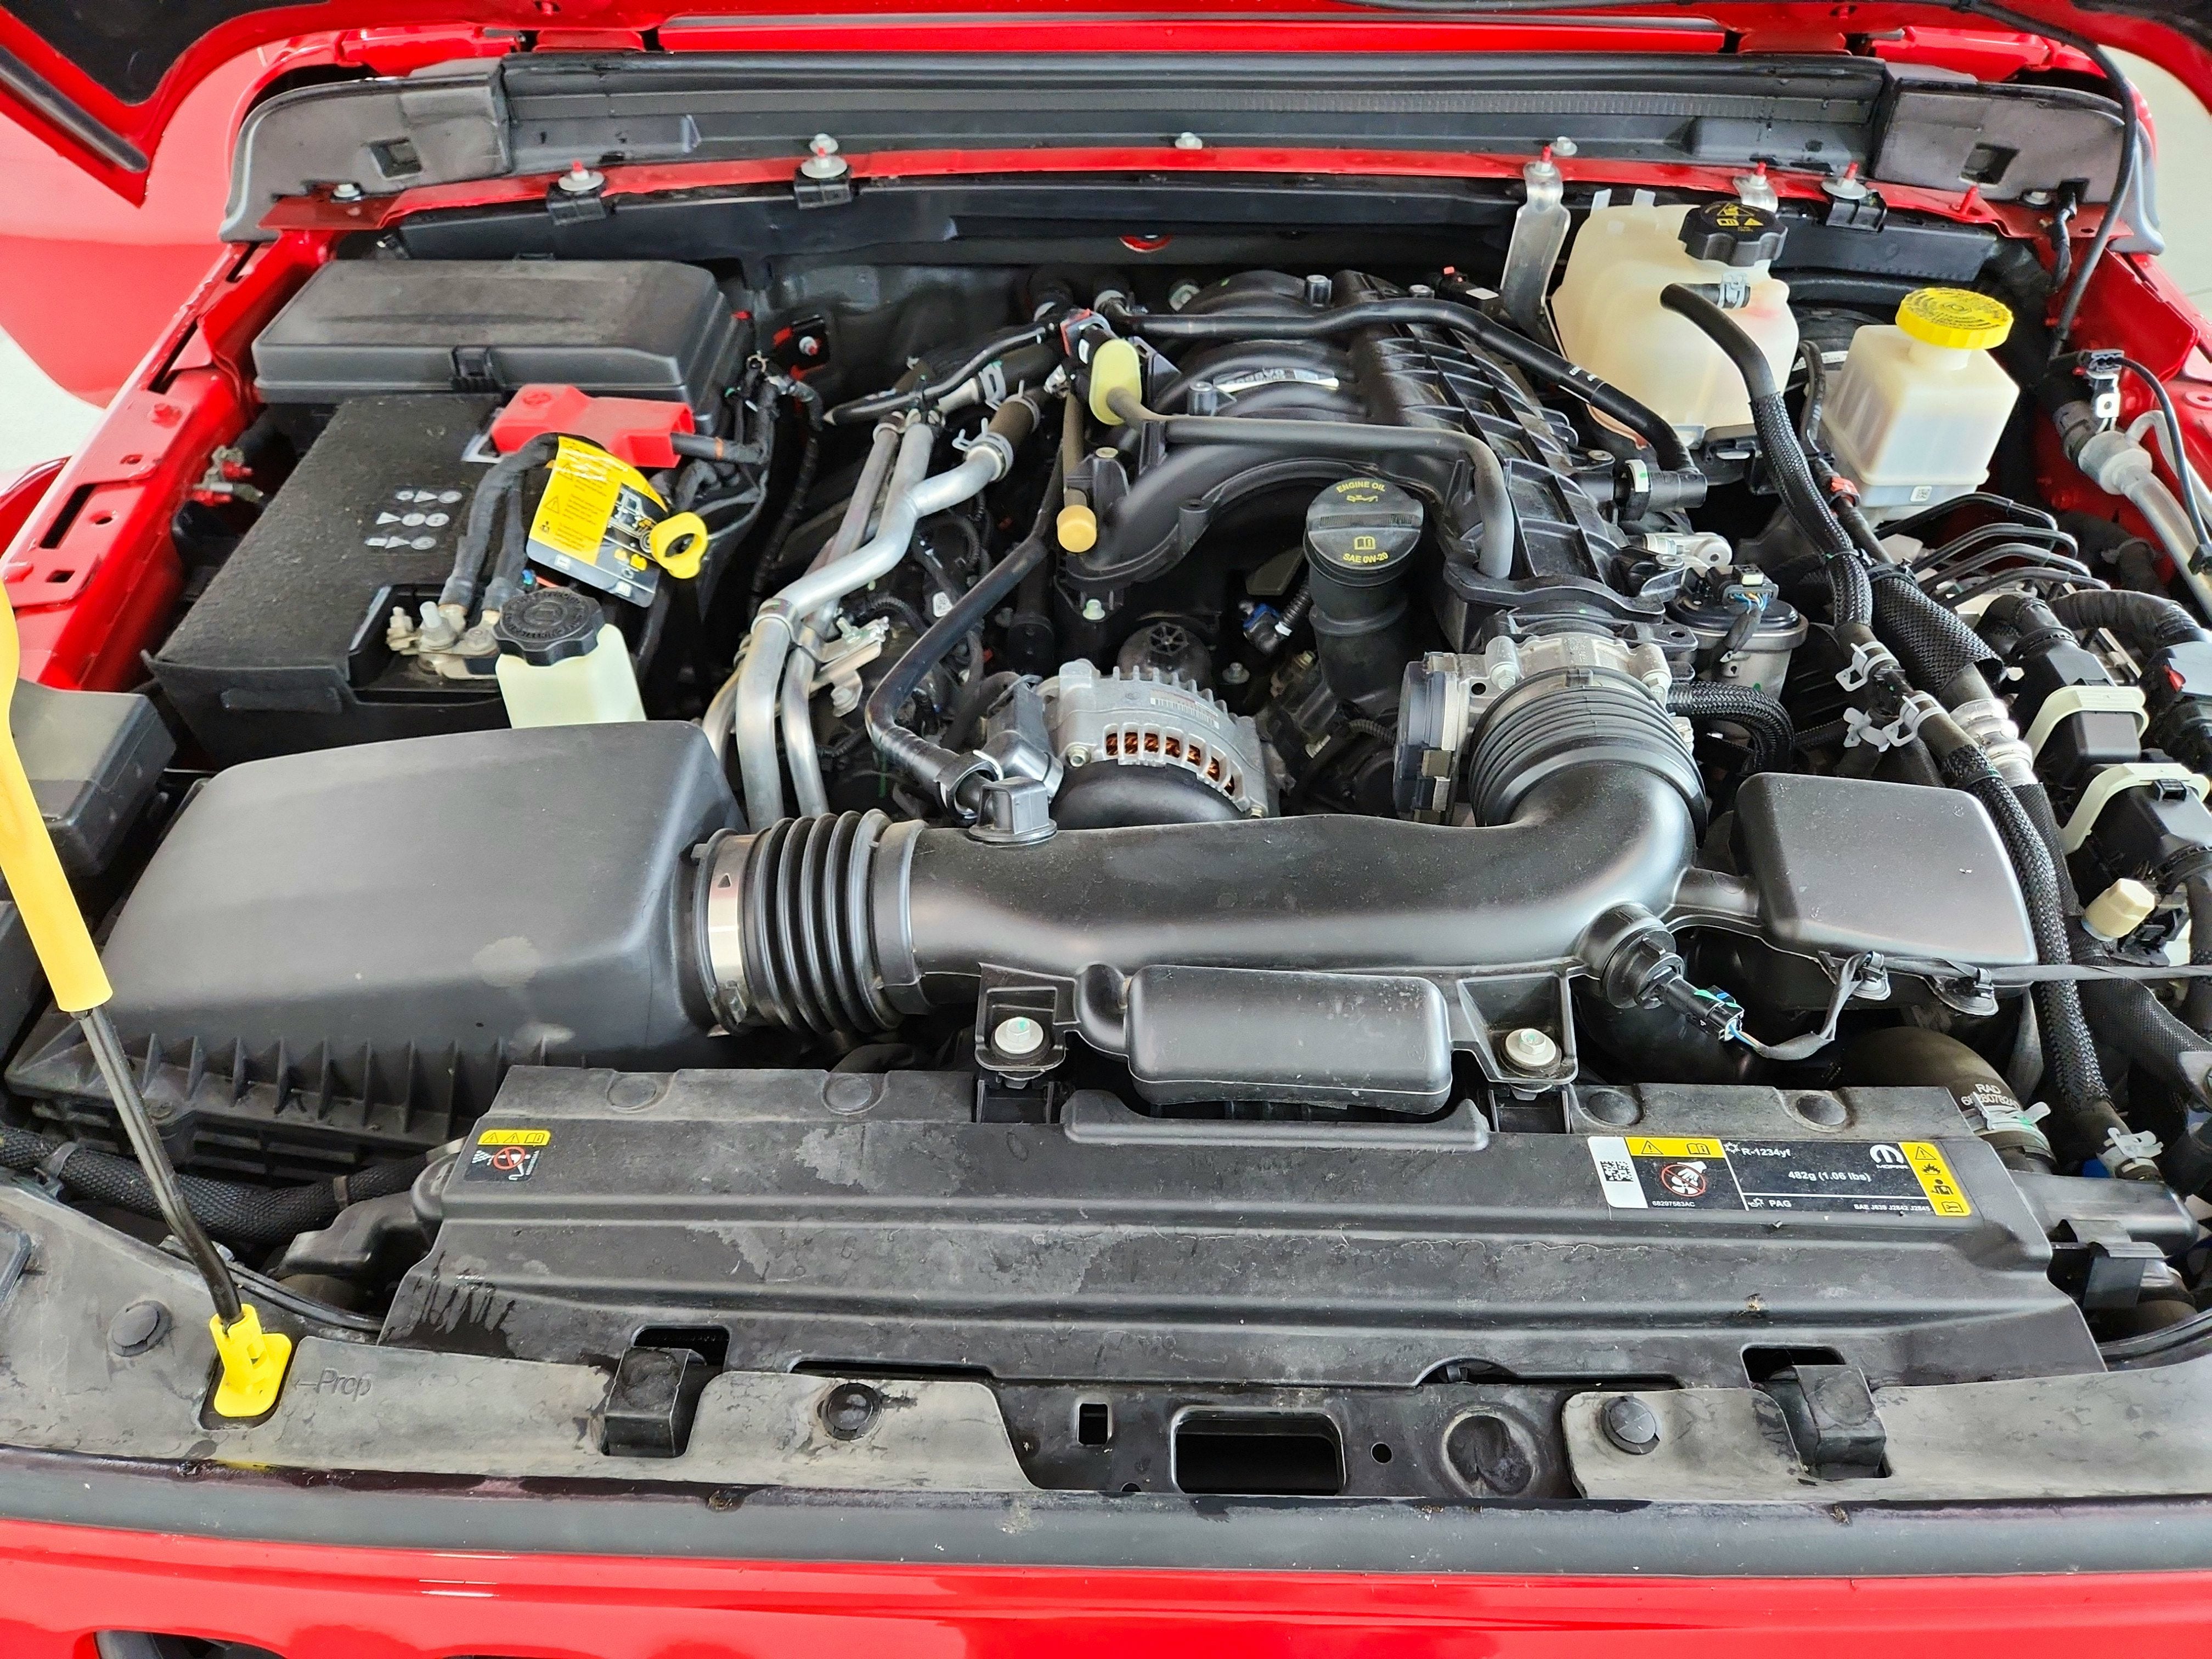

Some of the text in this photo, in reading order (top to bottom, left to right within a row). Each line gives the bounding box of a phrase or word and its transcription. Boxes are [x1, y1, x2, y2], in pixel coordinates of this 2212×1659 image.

[1336, 481, 1386, 493] ENGINE OIL
[1343, 552, 1389, 563] SAE 0W-20
[1975, 1084, 2001, 1094] RAD
[1741, 1148, 1791, 1158] R-1234yf
[1788, 1171, 1872, 1182] 482g (1.06 lbs)
[1769, 1199, 1792, 1207] PAG
[314, 1368, 372, 1402] Prop
